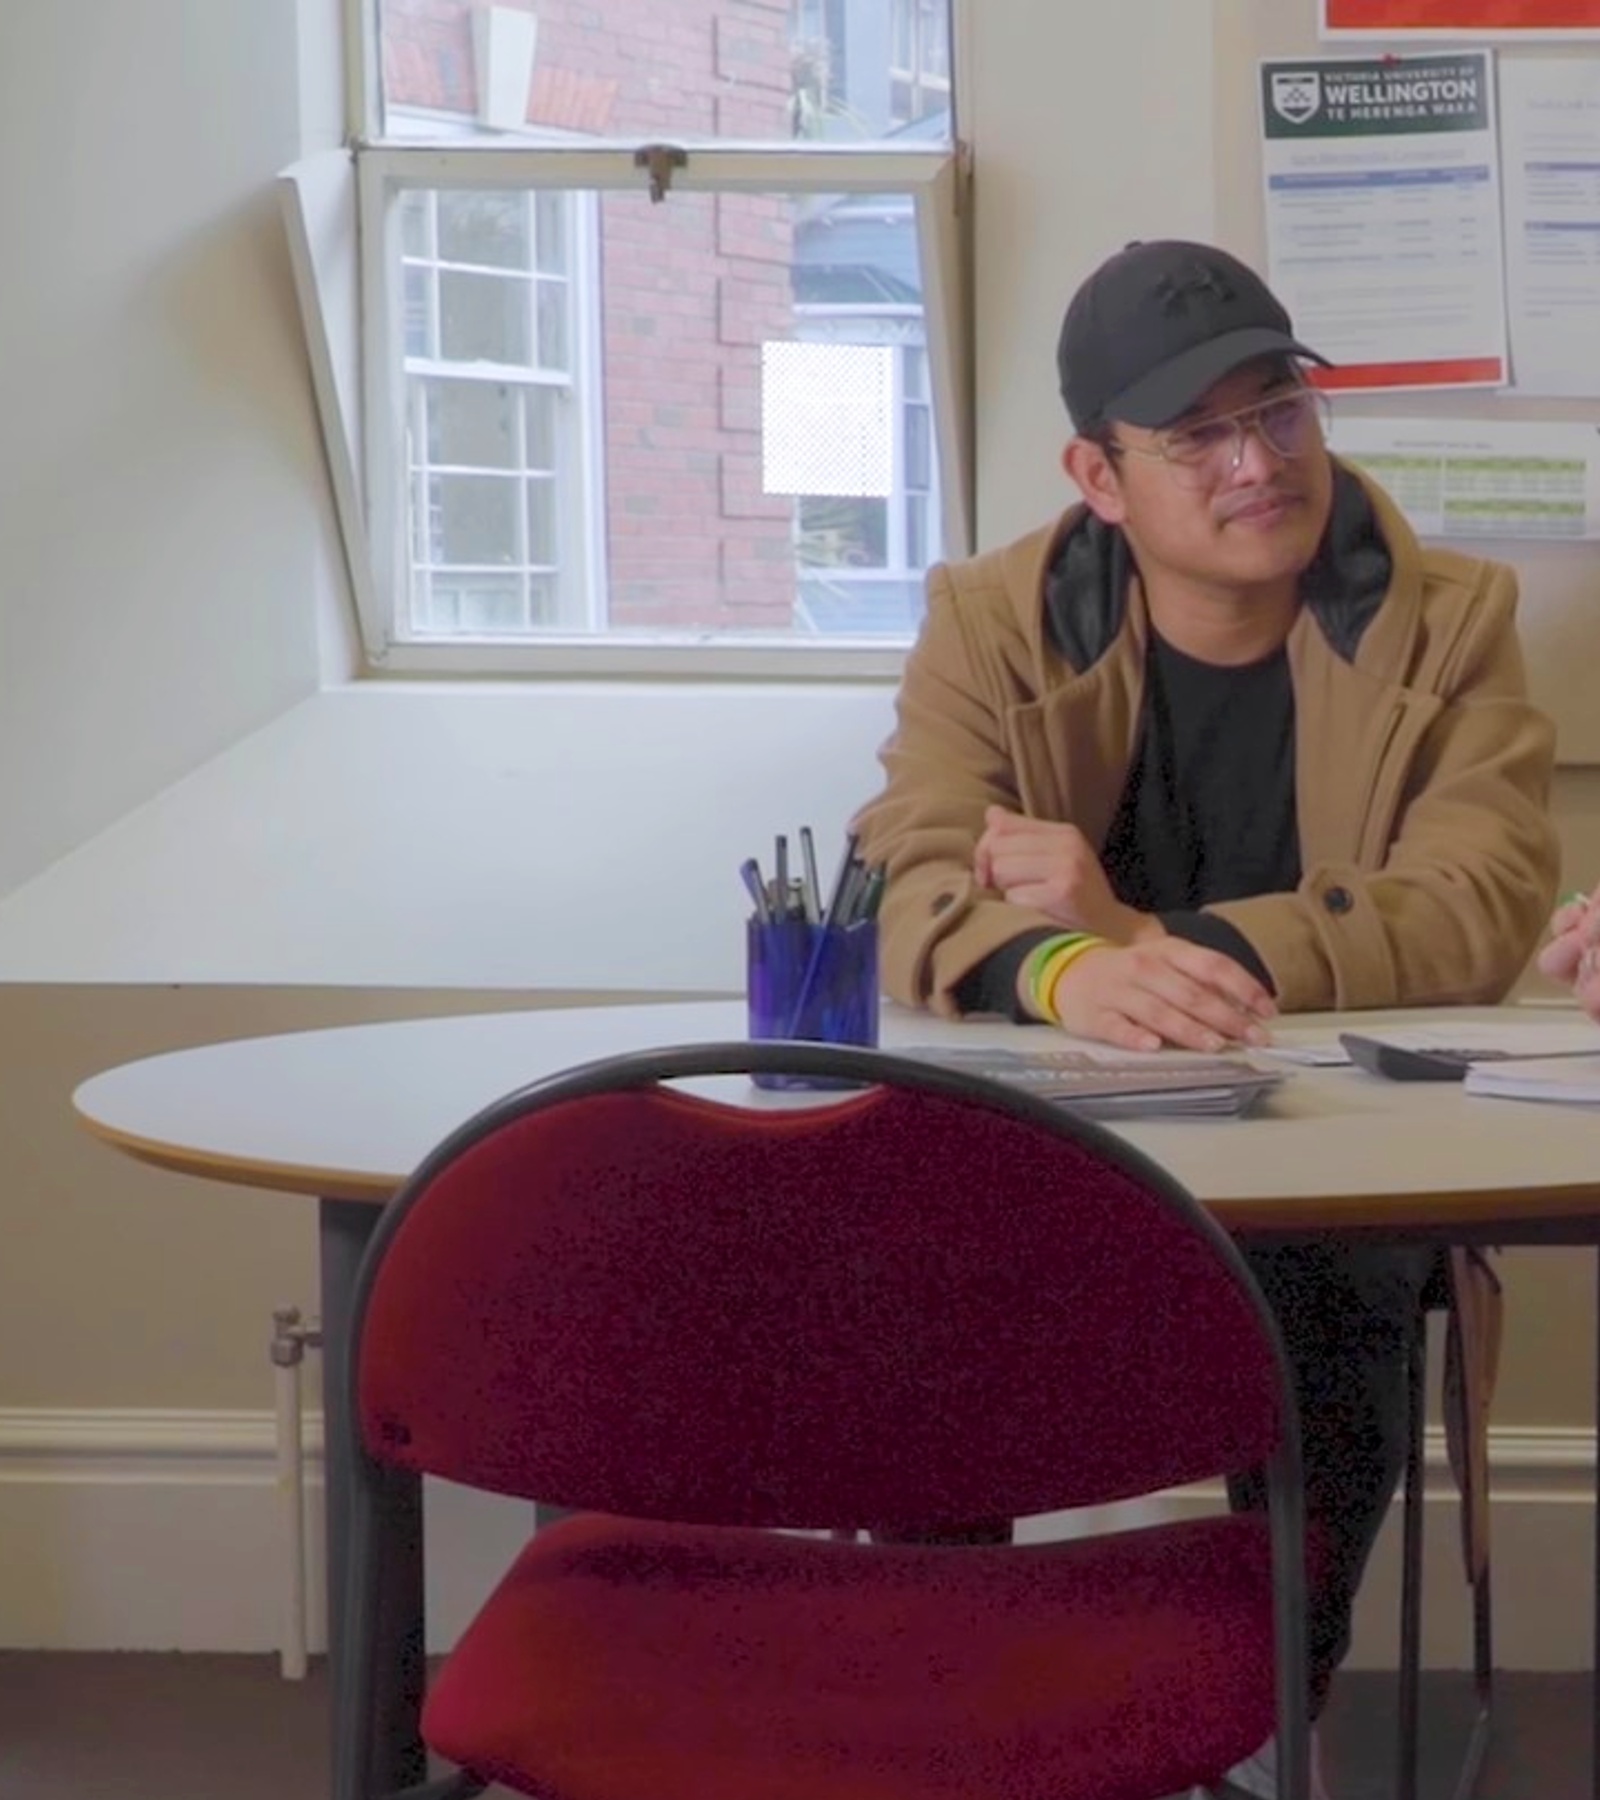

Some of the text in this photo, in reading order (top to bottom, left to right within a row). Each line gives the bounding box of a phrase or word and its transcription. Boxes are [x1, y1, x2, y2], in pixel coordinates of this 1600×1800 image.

[1325, 66, 1476, 83] VICTORIA UNIVERSITY OF
[1325, 80, 1477, 105] WELLINGTON
[1326, 103, 1477, 120] TE HERENGA WAKA
